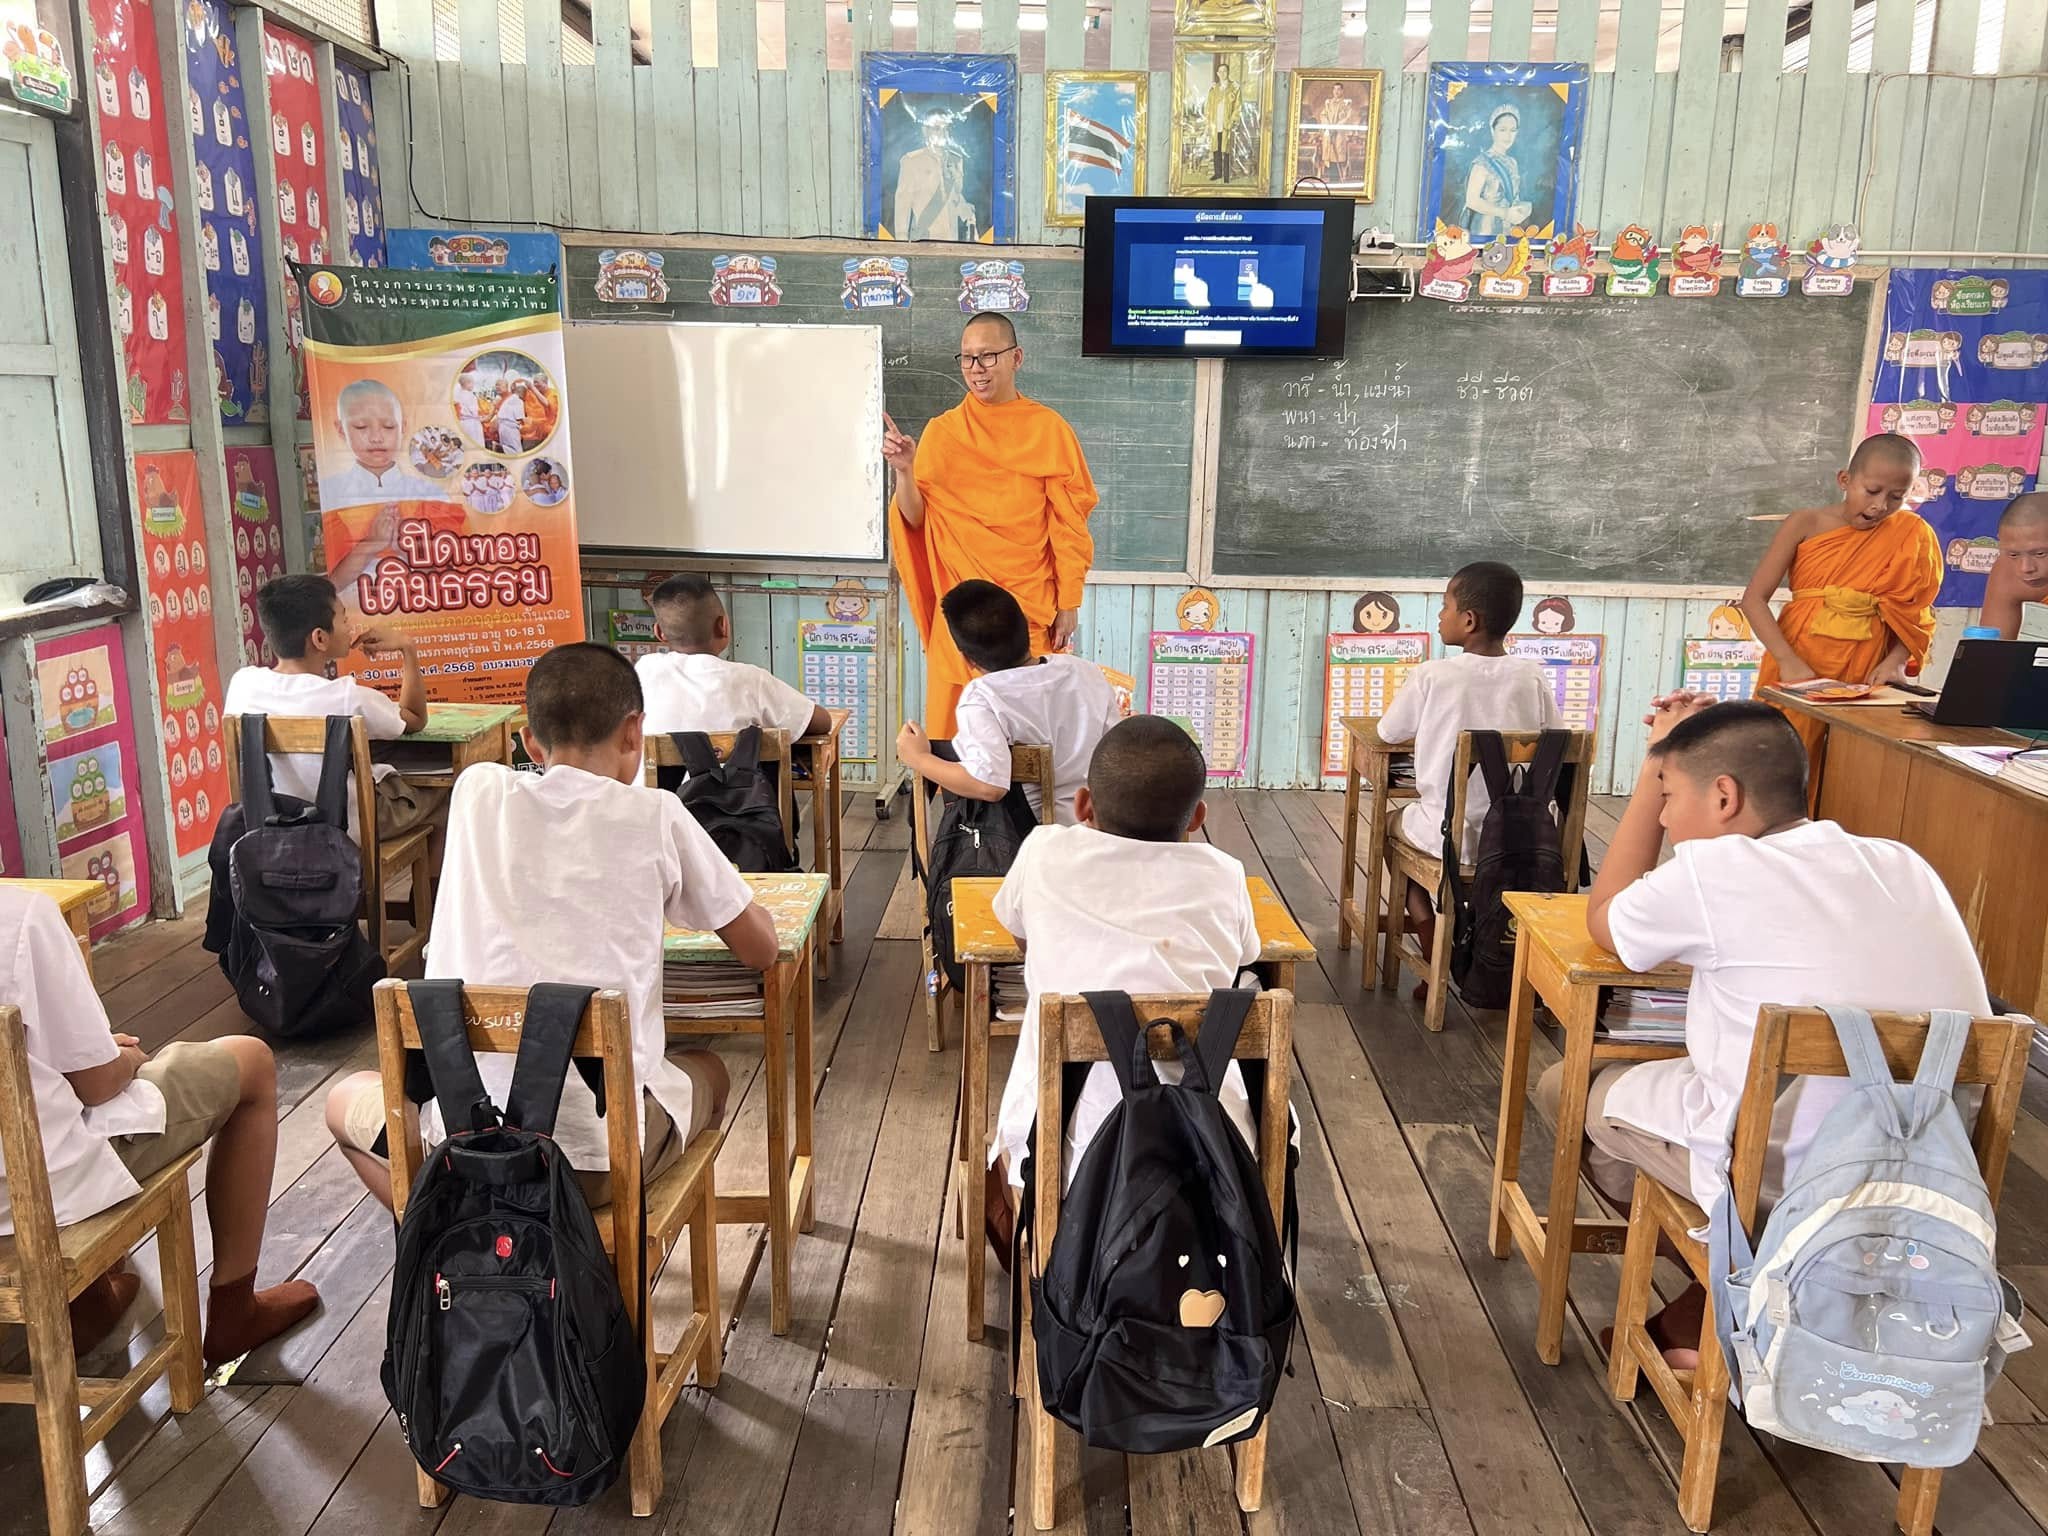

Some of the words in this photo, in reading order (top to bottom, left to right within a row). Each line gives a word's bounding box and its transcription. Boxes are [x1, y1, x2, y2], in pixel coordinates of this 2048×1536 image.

[448, 238, 492, 252] Color
[351, 274, 547, 295] โครงการบรรพชาสามเณร
[353, 290, 549, 310] ฟื้นฟูพระพุทธศาสนาทั่วไทย
[1282, 373, 1314, 398] วารี
[1363, 361, 1411, 399] แม่น้ำ
[1492, 372, 1533, 401] ชีวิต
[1282, 409, 1316, 425] พนา
[1333, 400, 1357, 427] ป่า
[1283, 433, 1316, 450] นภา
[1344, 414, 1407, 451] ท้องฟ้า
[400, 518, 540, 568] ปิดเทอม
[358, 558, 552, 615] เติมธรรม
[481, 629, 502, 644] อายุ
[504, 627, 535, 640] 10-18
[537, 624, 546, 636] ปี
[840, 633, 858, 643] สระ
[492, 640, 502, 655] ปี
[503, 638, 555, 653] พ.ศ.2568
[1174, 643, 1189, 653] อ่าน
[1190, 643, 1208, 654] สระ
[1351, 643, 1366, 653] อ่าน
[1368, 643, 1385, 654] สระ
[1524, 645, 1540, 655] อ่าน
[1541, 645, 1559, 655] สระ
[1725, 649, 1743, 660] สระ
[444, 660, 477, 674] 2568
[1839, 1361, 1934, 1398] Cinnamoroll
